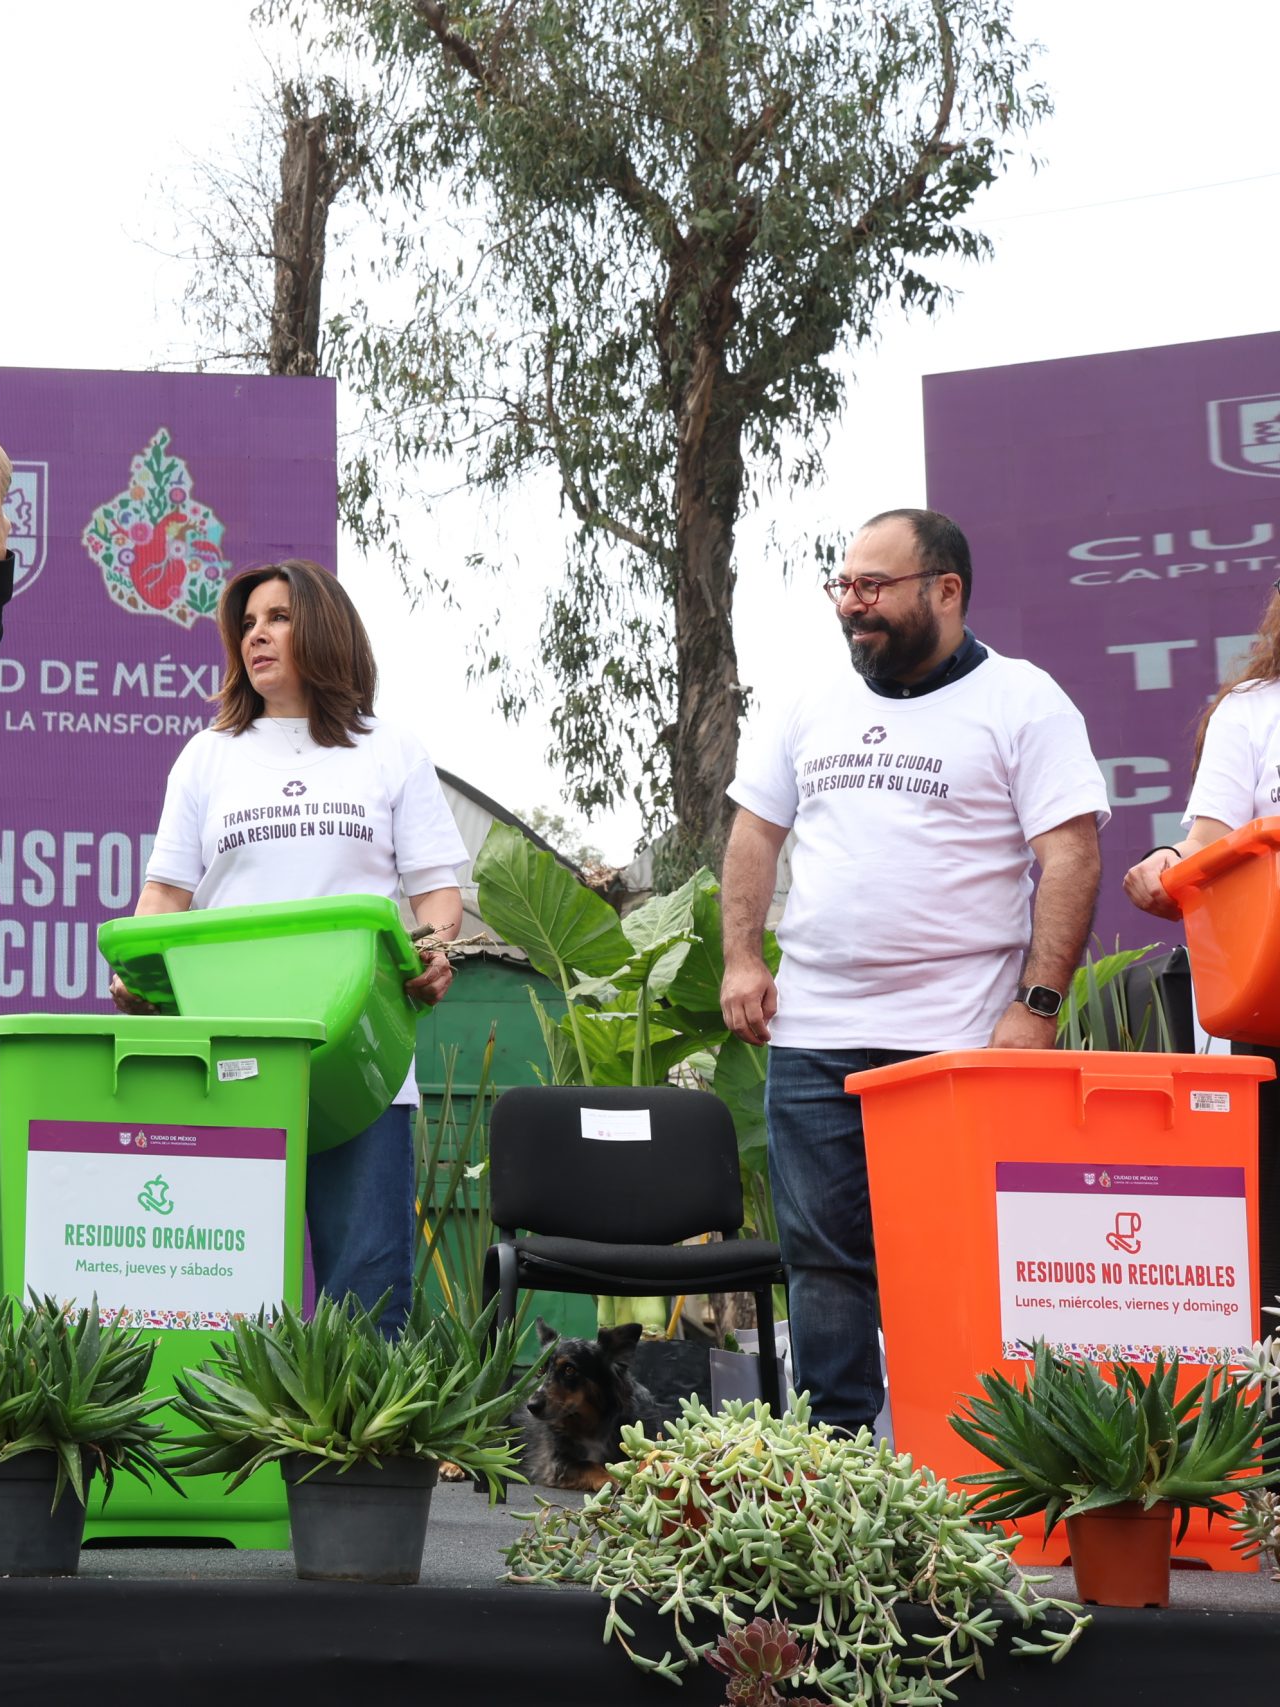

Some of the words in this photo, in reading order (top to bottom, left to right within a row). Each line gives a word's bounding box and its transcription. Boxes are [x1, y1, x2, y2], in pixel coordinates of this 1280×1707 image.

[1068, 523, 1273, 561] CIU
[1070, 556, 1280, 586] CAPIT
[40, 660, 98, 695] DE
[113, 655, 219, 699] MÉXI
[5, 710, 36, 731] LA
[42, 711, 218, 736] TRANSFORM
[803, 753, 874, 777] TRANSFORMA
[877, 753, 893, 767] TU
[895, 754, 942, 774] CIUDAD
[817, 774, 865, 793] RESIDUO
[867, 774, 884, 789] EN
[887, 775, 904, 791] SU
[906, 776, 949, 799] LUGAR
[223, 804, 301, 828] TRANSFORMA
[304, 802, 319, 815] TU
[322, 802, 366, 818] CIUDAD
[217, 831, 246, 854] CADA
[248, 822, 297, 843] RESIDUO
[300, 821, 315, 837] EN
[319, 820, 334, 836] SU
[338, 820, 374, 843] LUGAR
[65, 1224, 146, 1248] RESIDUOS
[152, 1225, 246, 1251] ORGÁNICOS
[75, 1259, 122, 1274] Martes,
[125, 1261, 166, 1276] jueves
[169, 1265, 178, 1278] y
[180, 1261, 233, 1276] sábados
[1016, 1260, 1096, 1284] RESIDUOS
[1101, 1263, 1123, 1284] NO
[1128, 1263, 1235, 1288] RECICLABLES
[1015, 1295, 1056, 1309] Lunes,
[1058, 1296, 1122, 1311] miércoles,
[1125, 1298, 1169, 1311] viernes
[1172, 1301, 1180, 1314] y
[1183, 1299, 1239, 1316] domingo
